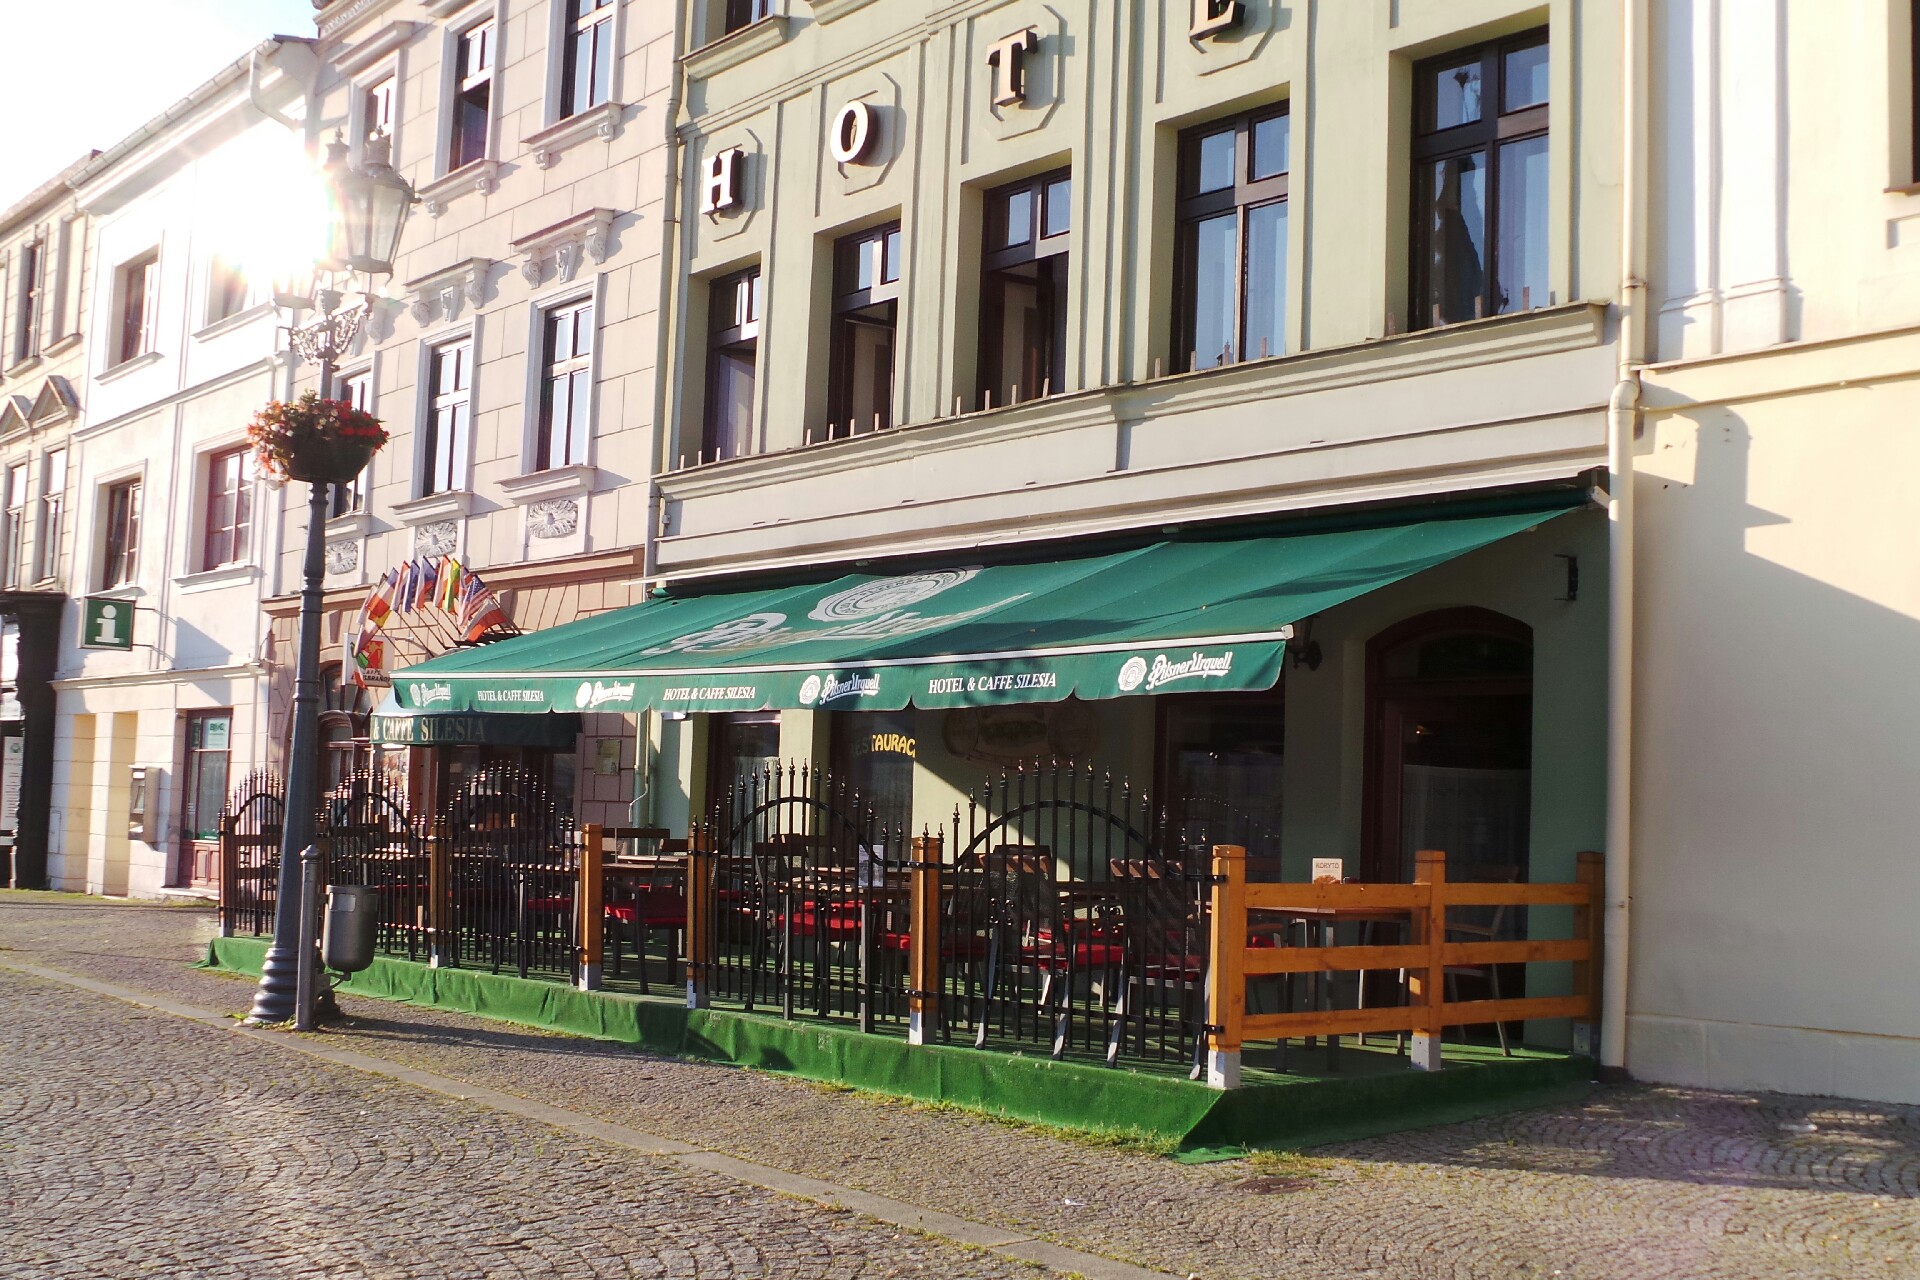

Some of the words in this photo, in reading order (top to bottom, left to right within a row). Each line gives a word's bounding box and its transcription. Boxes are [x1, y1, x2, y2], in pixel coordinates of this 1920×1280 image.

[1145, 654, 1193, 690] Pilsner
[1190, 652, 1233, 678] Urquell
[663, 688, 690, 701] HOTEL
[691, 688, 698, 700] &
[699, 687, 726, 700] CAFFE
[725, 686, 756, 699] SILESIA
[819, 674, 853, 705] Pilsner
[851, 673, 880, 697] Urquell
[928, 678, 964, 694] HOTEL
[967, 677, 976, 691] &
[978, 675, 1013, 691] CAFFE
[1014, 673, 1056, 688] SILESIA
[477, 690, 497, 701] HOTEL
[497, 690, 503, 701] &
[503, 690, 522, 701] CAFFE
[522, 690, 544, 702] SILESIA
[373, 717, 380, 740] &
[383, 717, 414, 741] CAFFE
[421, 717, 486, 742] SILESIA
